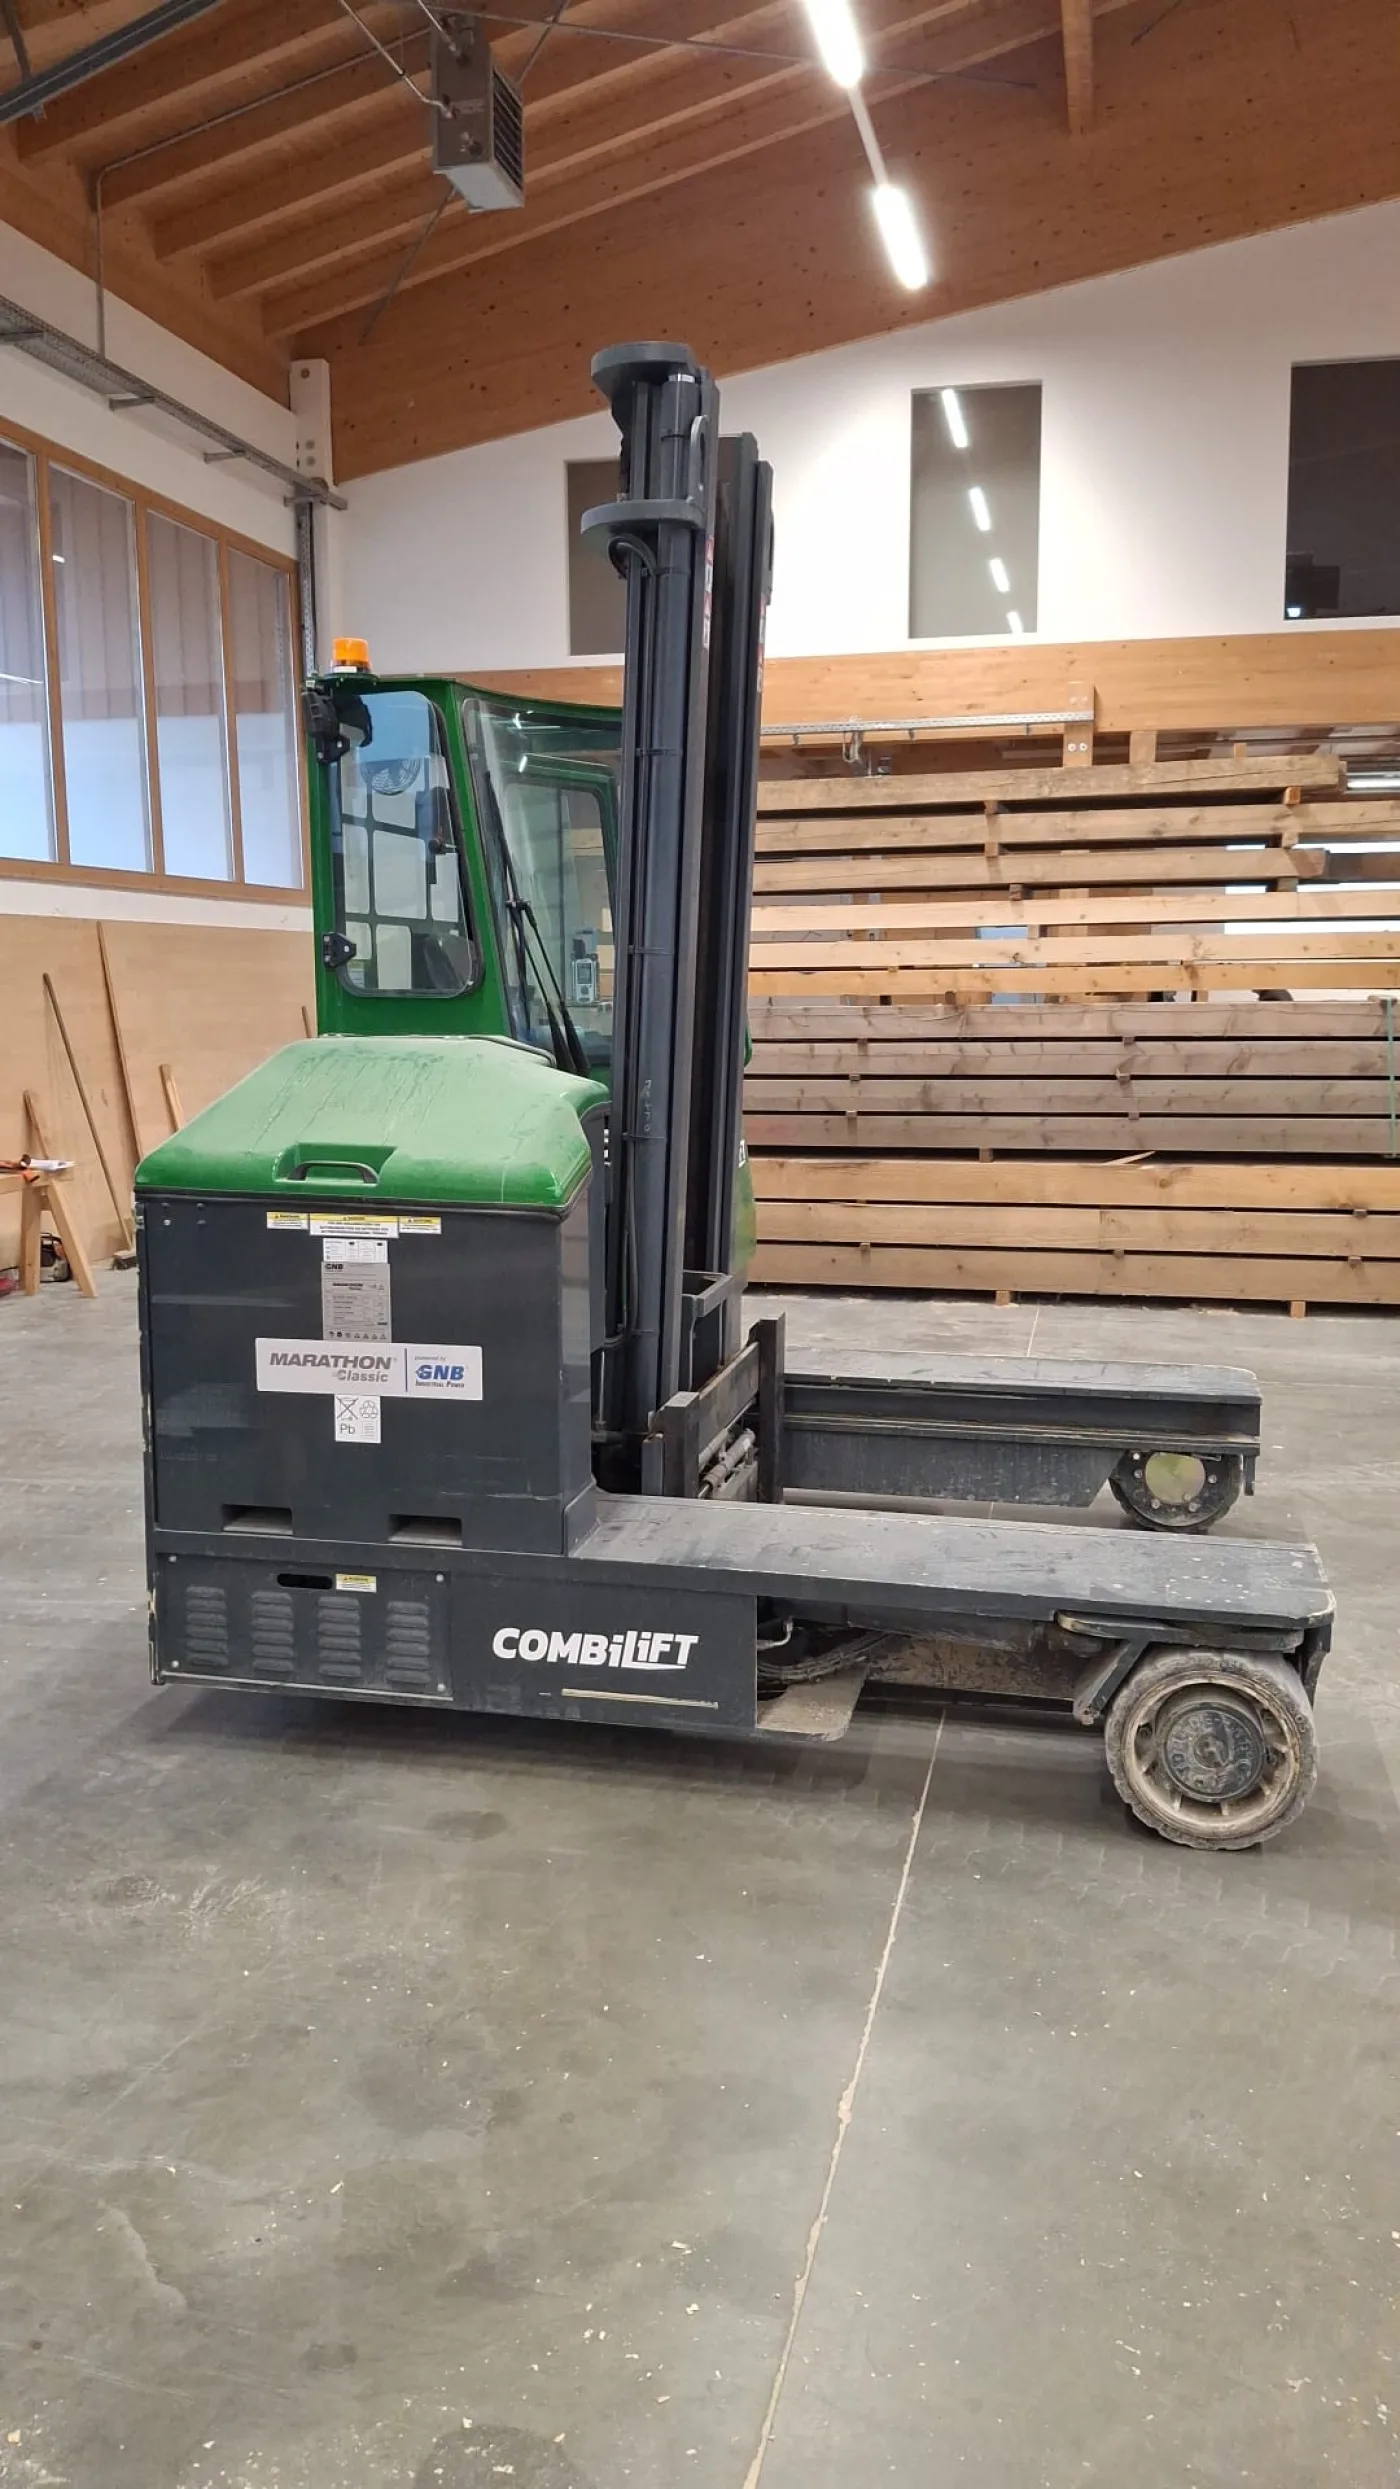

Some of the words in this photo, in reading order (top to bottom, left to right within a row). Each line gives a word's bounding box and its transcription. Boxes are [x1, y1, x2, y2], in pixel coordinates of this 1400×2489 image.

[269, 1352, 392, 1370] MARATHON
[336, 1369, 390, 1383] Classic
[415, 1364, 465, 1381] GNB
[340, 1423, 356, 1435] Pb
